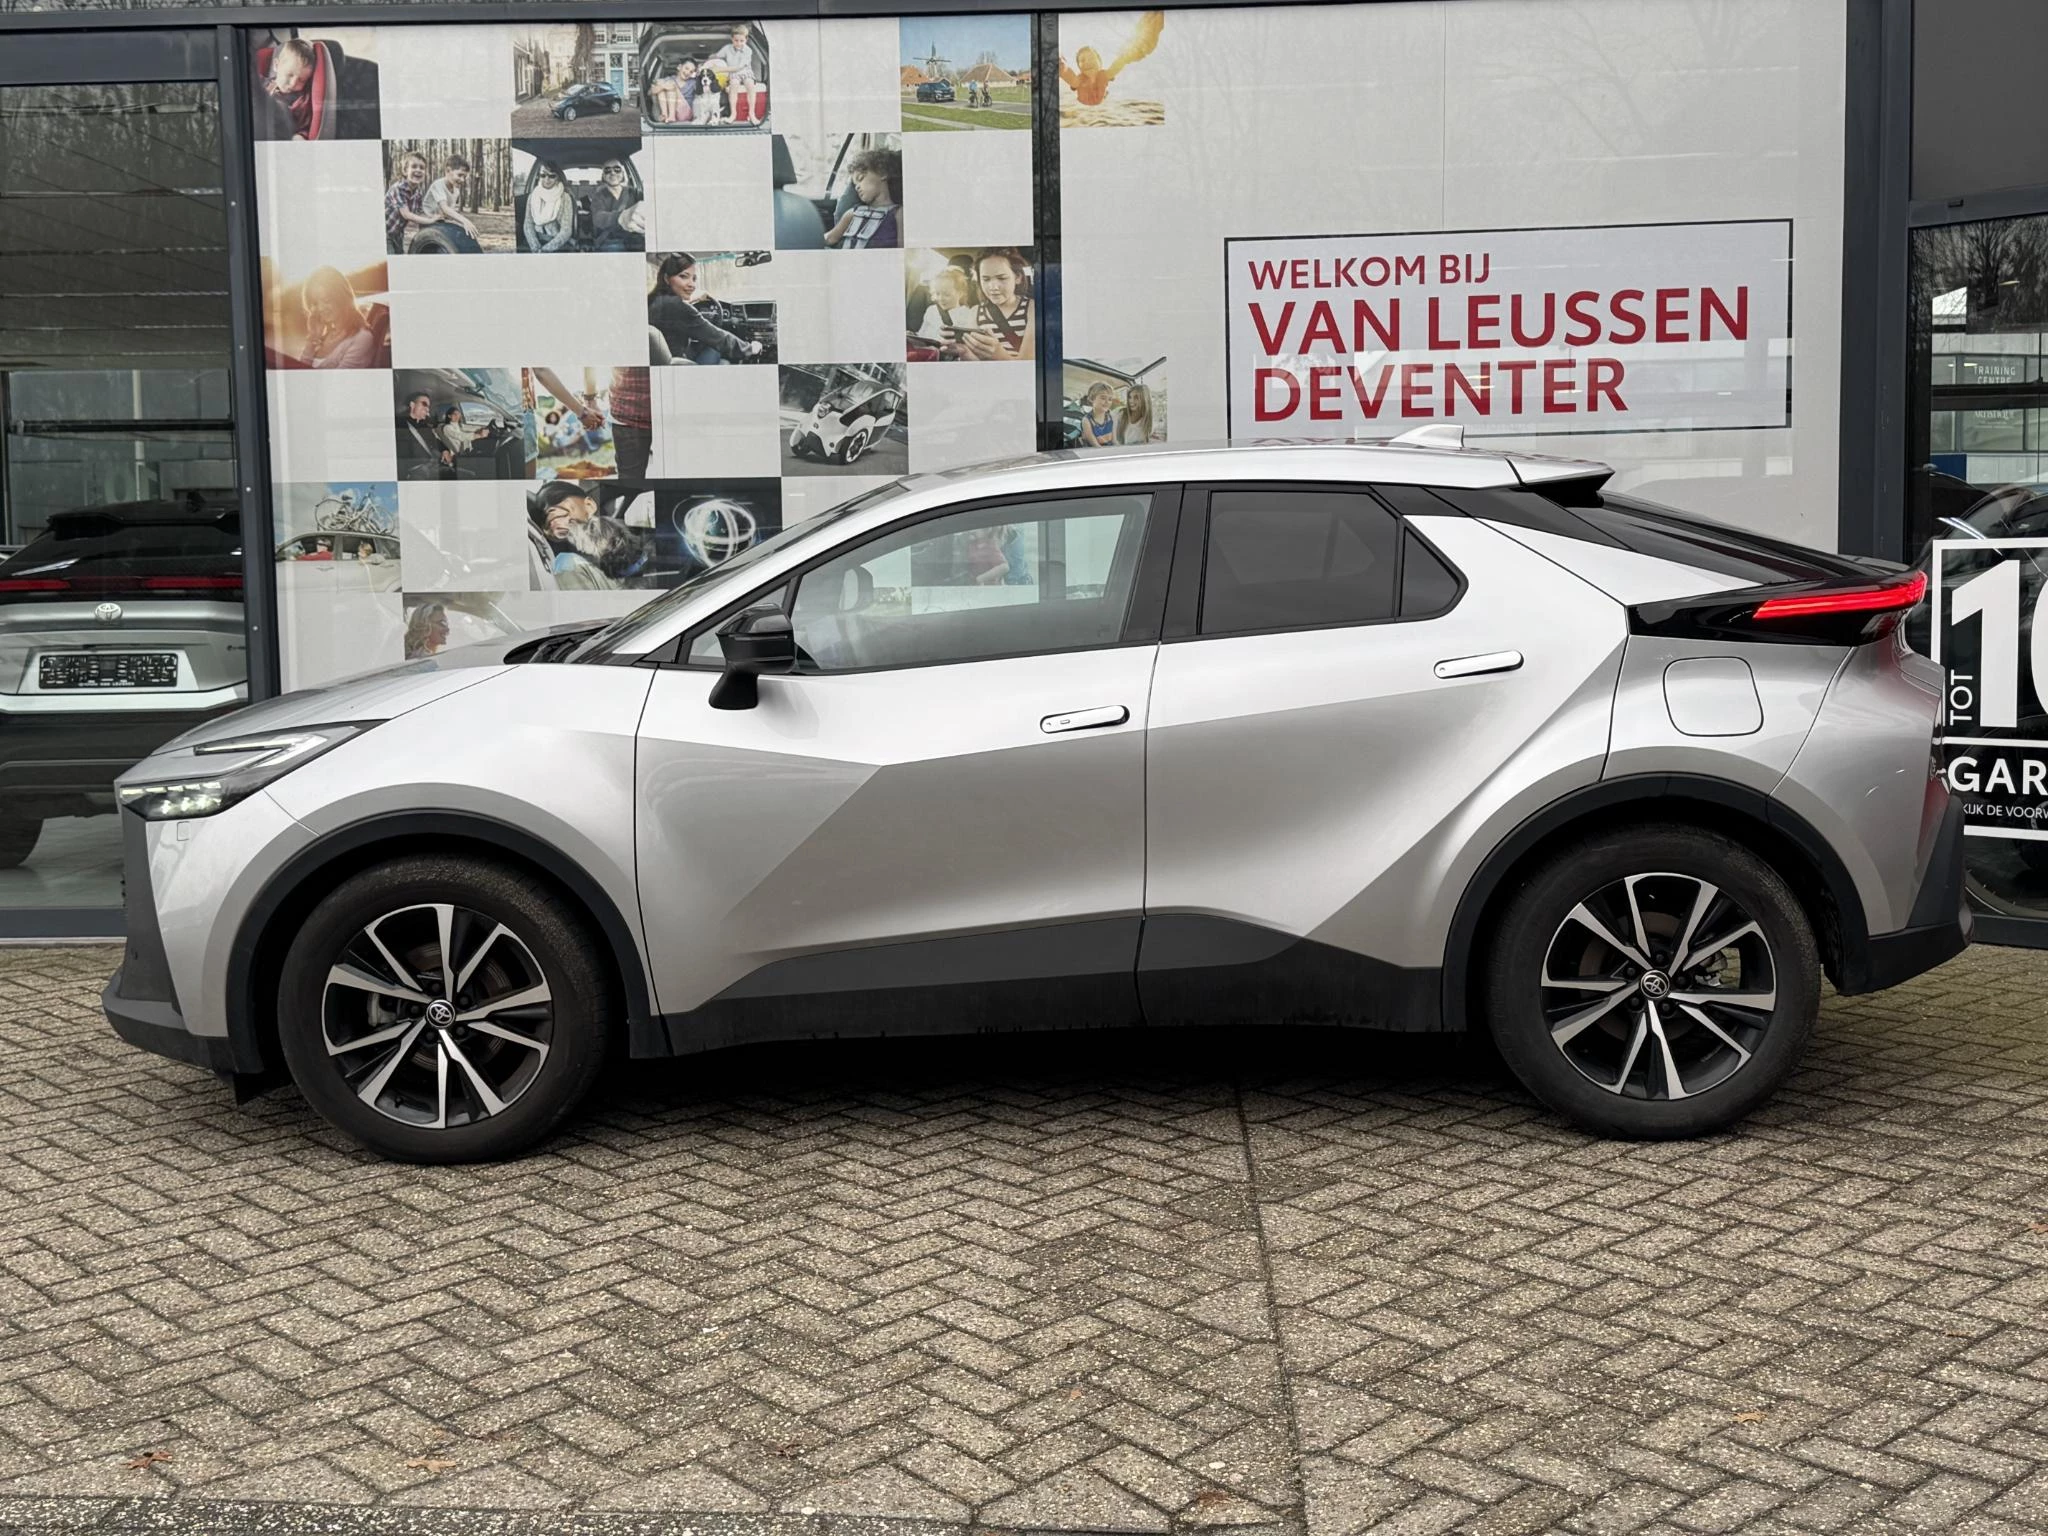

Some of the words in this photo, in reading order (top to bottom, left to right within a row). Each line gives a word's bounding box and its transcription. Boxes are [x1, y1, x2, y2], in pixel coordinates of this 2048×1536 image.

[1248, 256, 1425, 290] WELKOM
[1440, 253, 1490, 284] BIJ
[1248, 298, 1401, 356] VAN
[1428, 286, 1749, 351] LEUSSEN
[1254, 358, 1629, 422] DEVENTER
[1974, 366, 2016, 376] TRAINING
[1951, 559, 2048, 728] 1
[1950, 669, 1973, 726] TOT
[1986, 804, 2003, 817] DE
